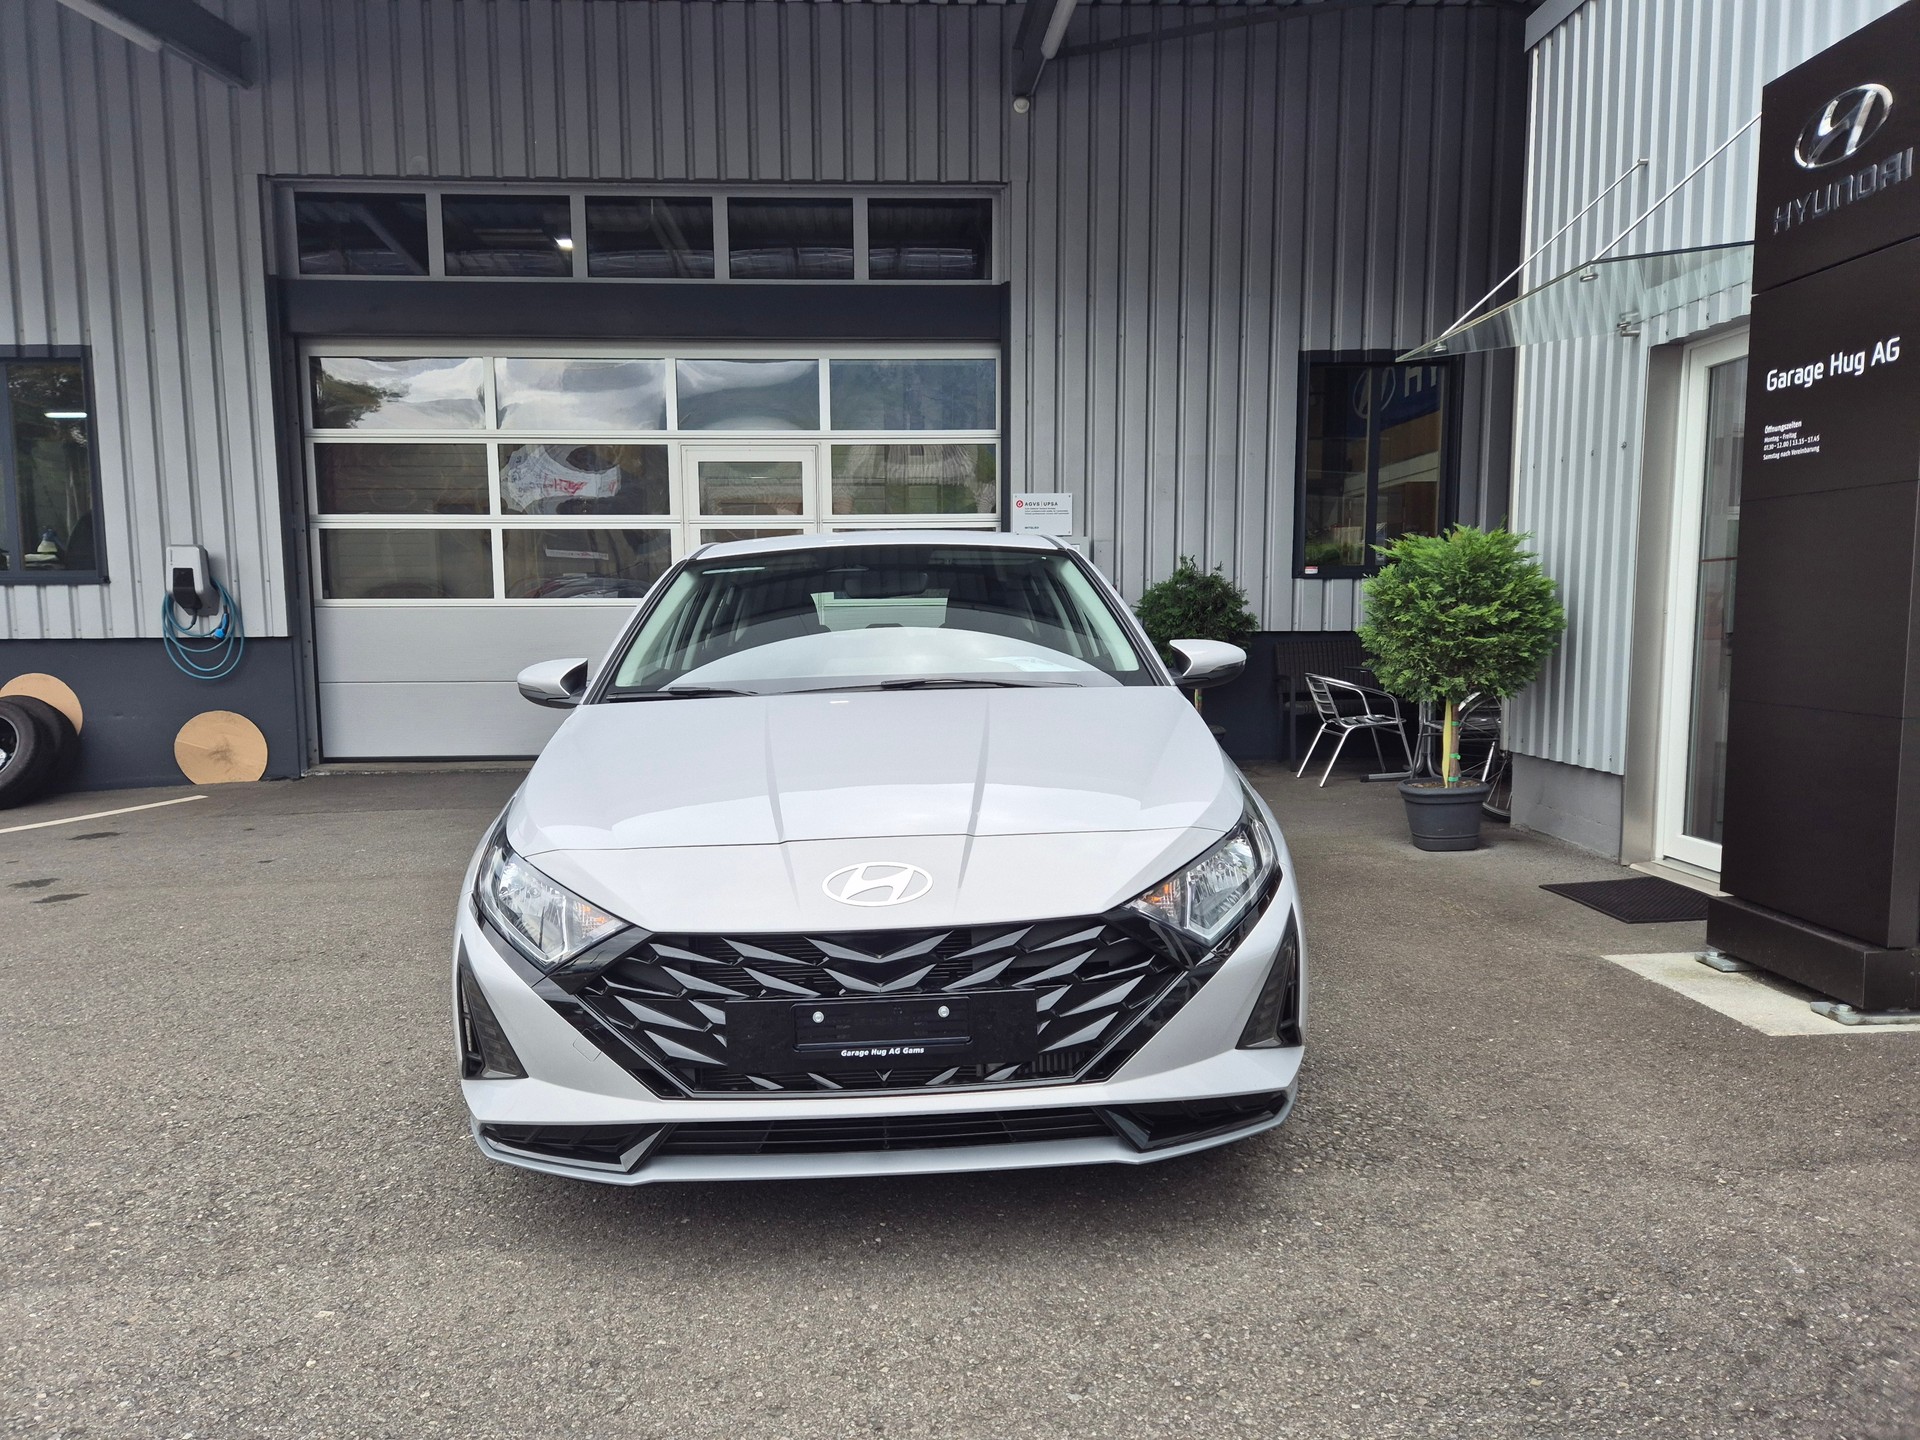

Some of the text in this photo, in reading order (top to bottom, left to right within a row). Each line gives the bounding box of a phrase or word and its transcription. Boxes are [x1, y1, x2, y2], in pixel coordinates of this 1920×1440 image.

[1774, 147, 1914, 235] HYUNDAI
[1766, 336, 1901, 391] Garage Hug AG
[1764, 421, 1802, 434] Öffnungszeiten
[1782, 432, 1797, 440] Freitag
[1763, 446, 1820, 460] Samstag nach Vereinbarung
[841, 1049, 869, 1057] Garage
